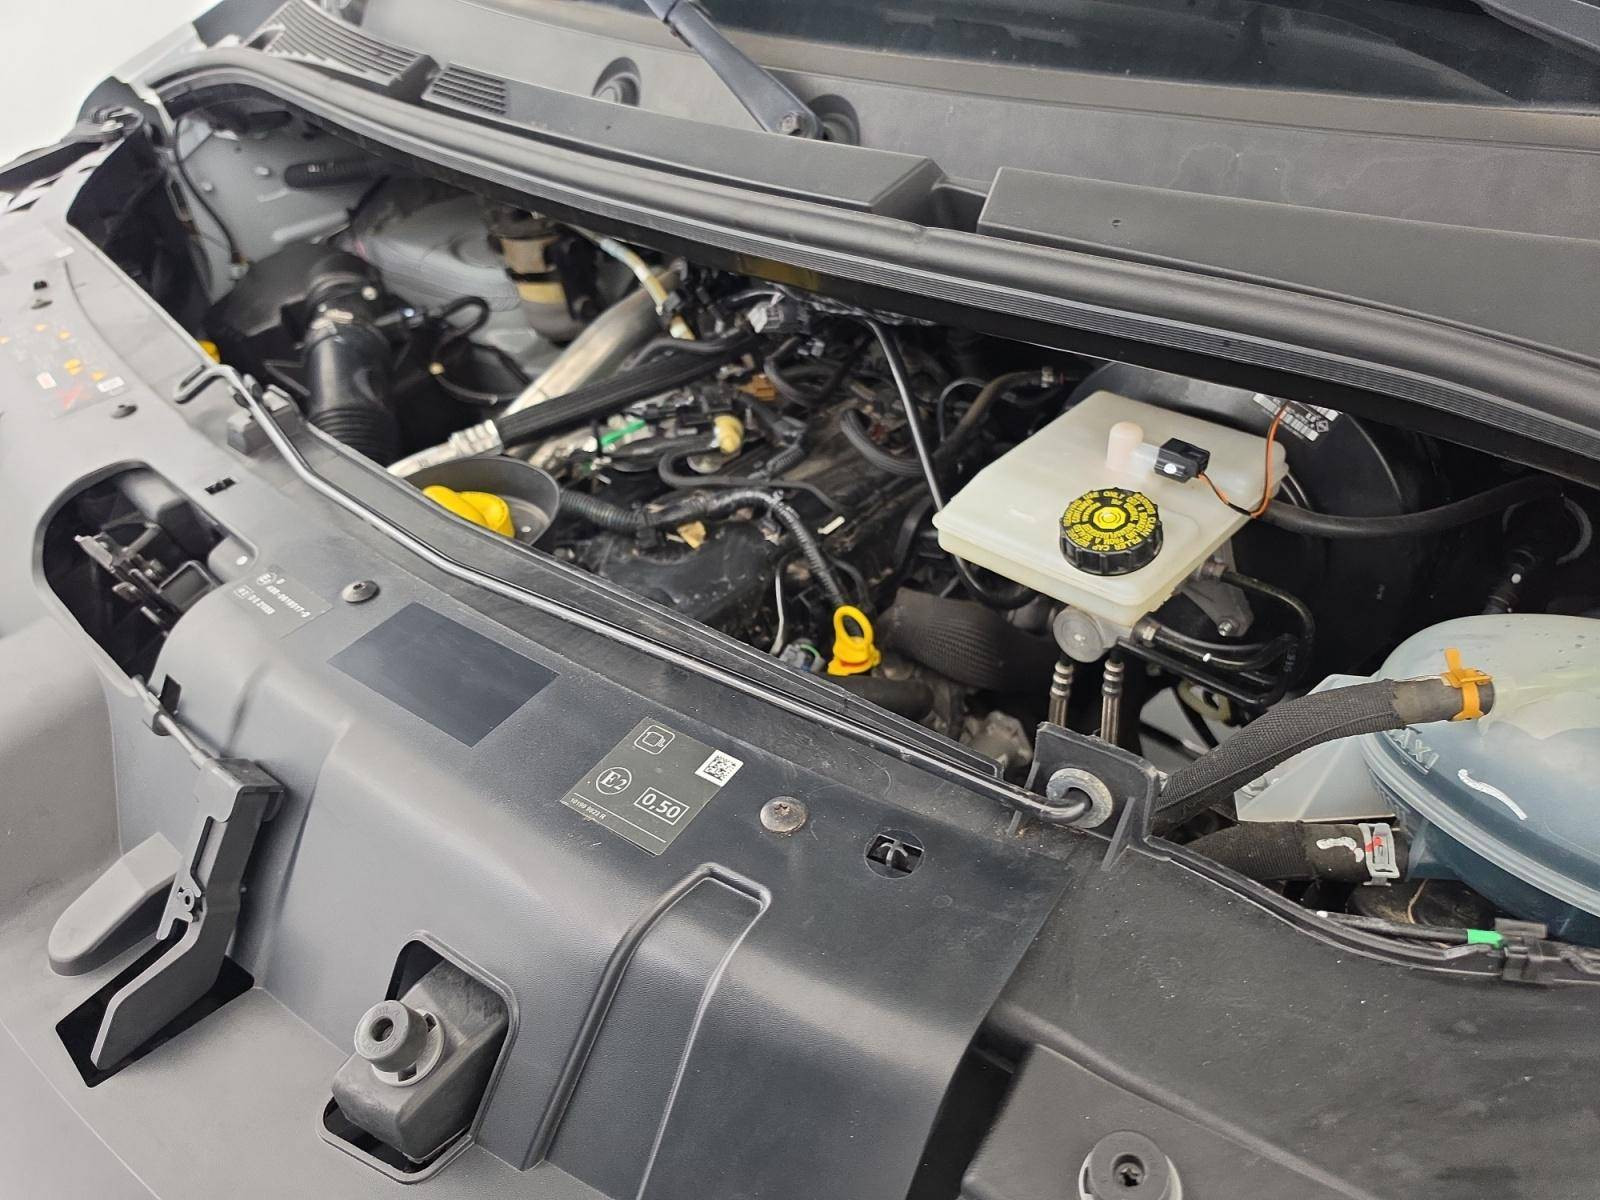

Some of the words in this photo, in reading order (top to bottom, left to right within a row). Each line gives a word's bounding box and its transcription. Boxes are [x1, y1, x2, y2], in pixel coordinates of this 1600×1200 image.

[1102, 490, 1126, 501] ONLY
[1139, 516, 1157, 538] CLEAN
[1114, 536, 1143, 551] FILLER
[1388, 727, 1440, 770] AXI
[600, 771, 628, 791] E2
[641, 793, 681, 819] 0,50
